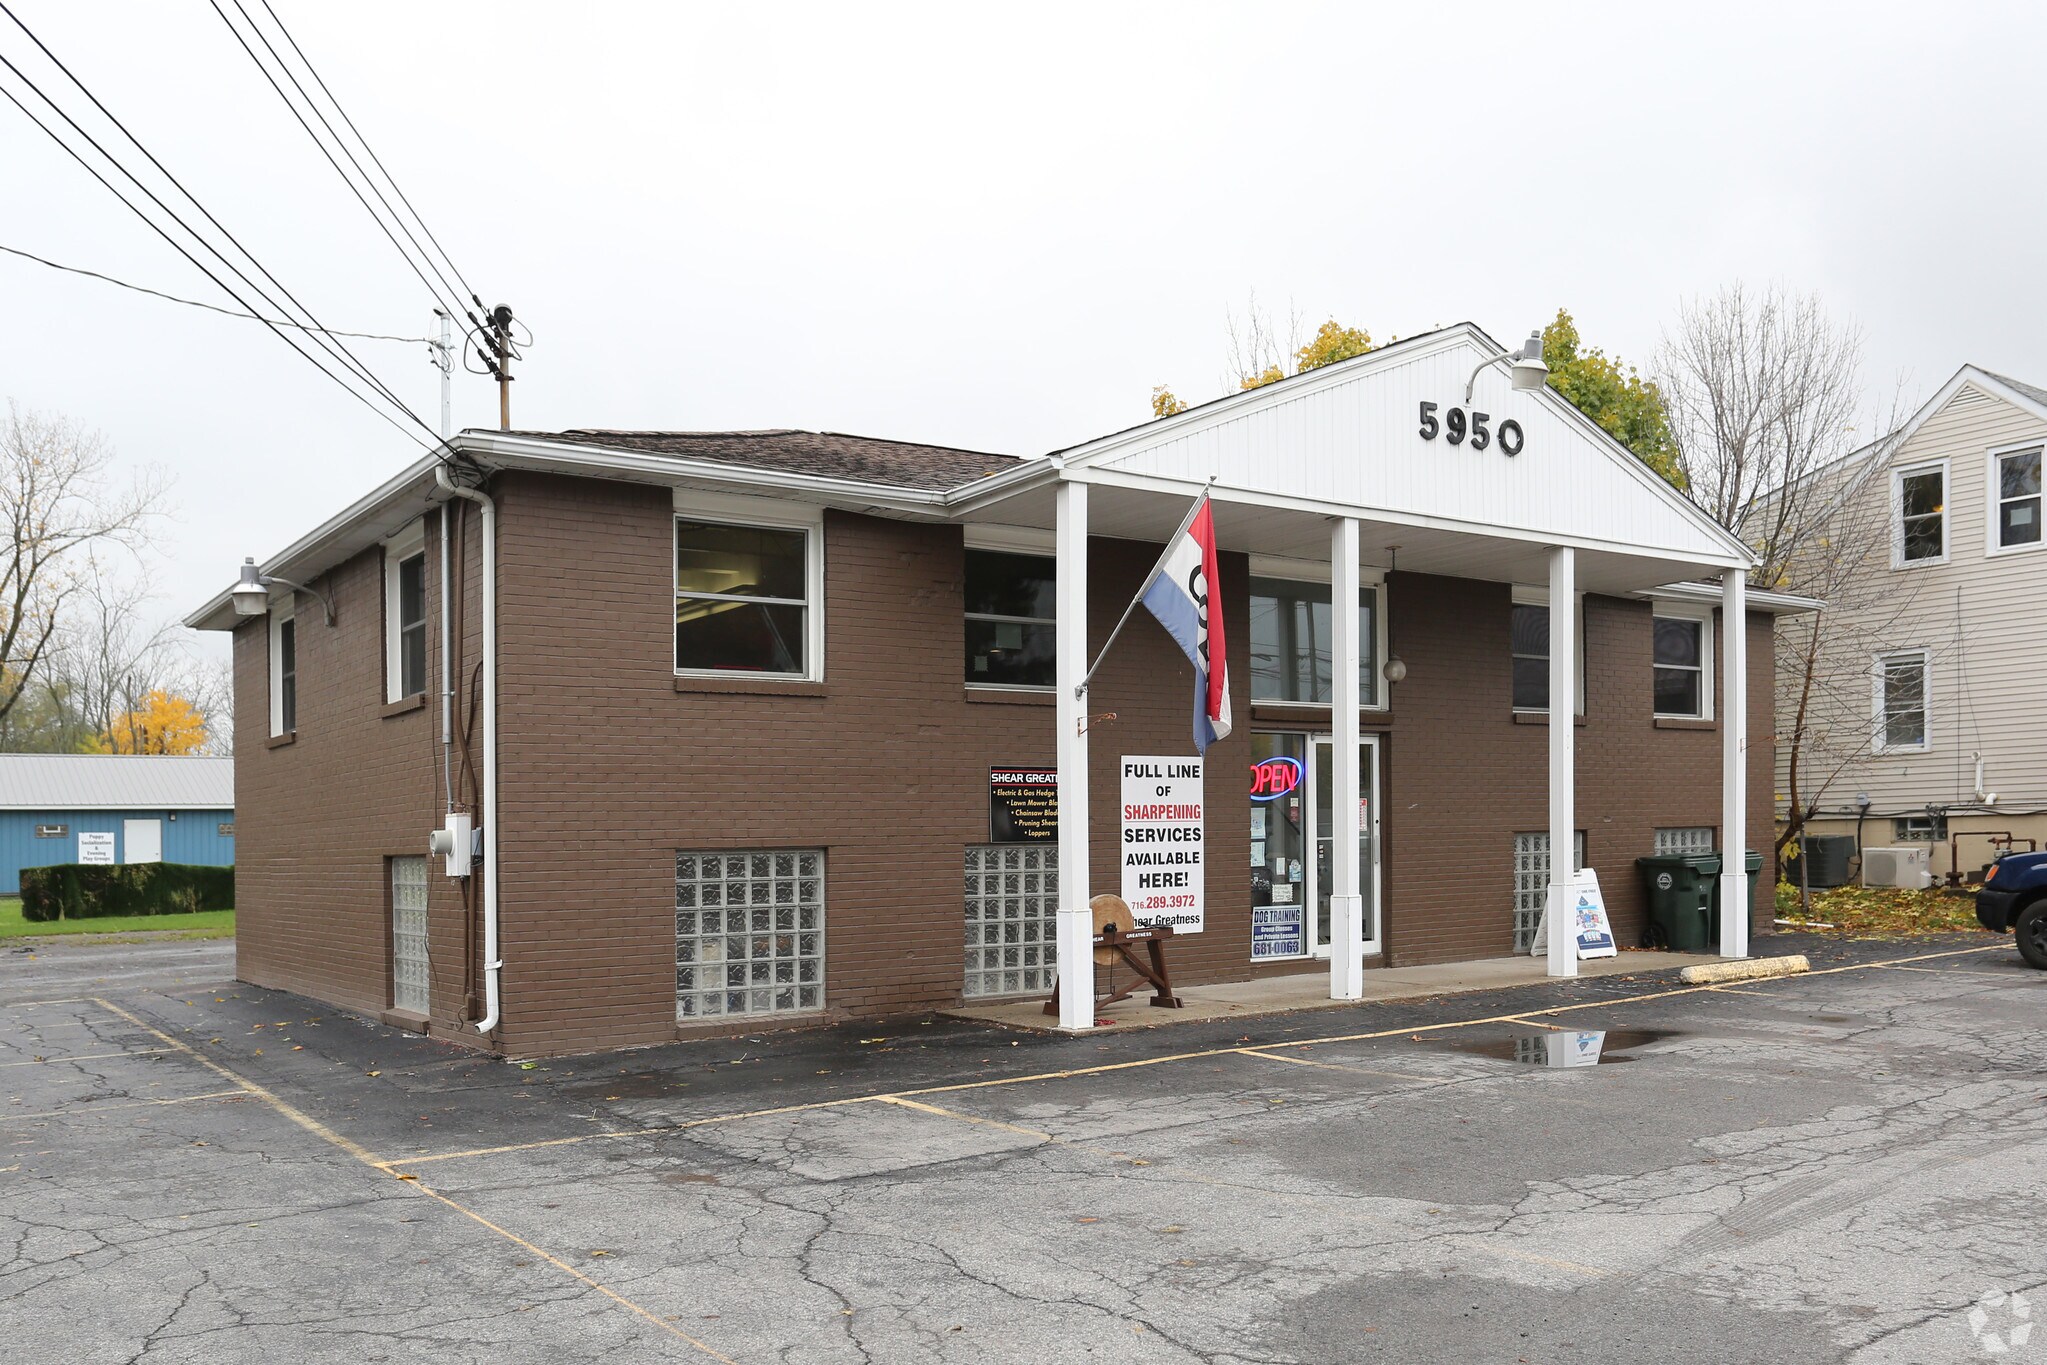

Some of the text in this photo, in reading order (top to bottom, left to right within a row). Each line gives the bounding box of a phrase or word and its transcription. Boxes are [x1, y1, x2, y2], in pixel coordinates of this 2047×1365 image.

[1419, 401, 1525, 457] 5950
[991, 773, 1024, 783] SHEAR
[1124, 764, 1200, 778] FULL LINE
[997, 788, 1016, 796] Electric
[1036, 788, 1055, 797] Hedge
[1156, 786, 1171, 797] OF
[1124, 804, 1201, 820] SHARPENING
[1018, 819, 1040, 827] Pruning
[1028, 829, 1051, 837] Loppers
[1124, 828, 1201, 843] SERVICES
[1126, 851, 1200, 866] AVAILABLE
[1139, 872, 1188, 888] HERE!
[1131, 895, 1195, 910] 716.289.3972
[1155, 914, 1200, 926] Greatness
[1254, 909, 1300, 923] DOG TRAINING
